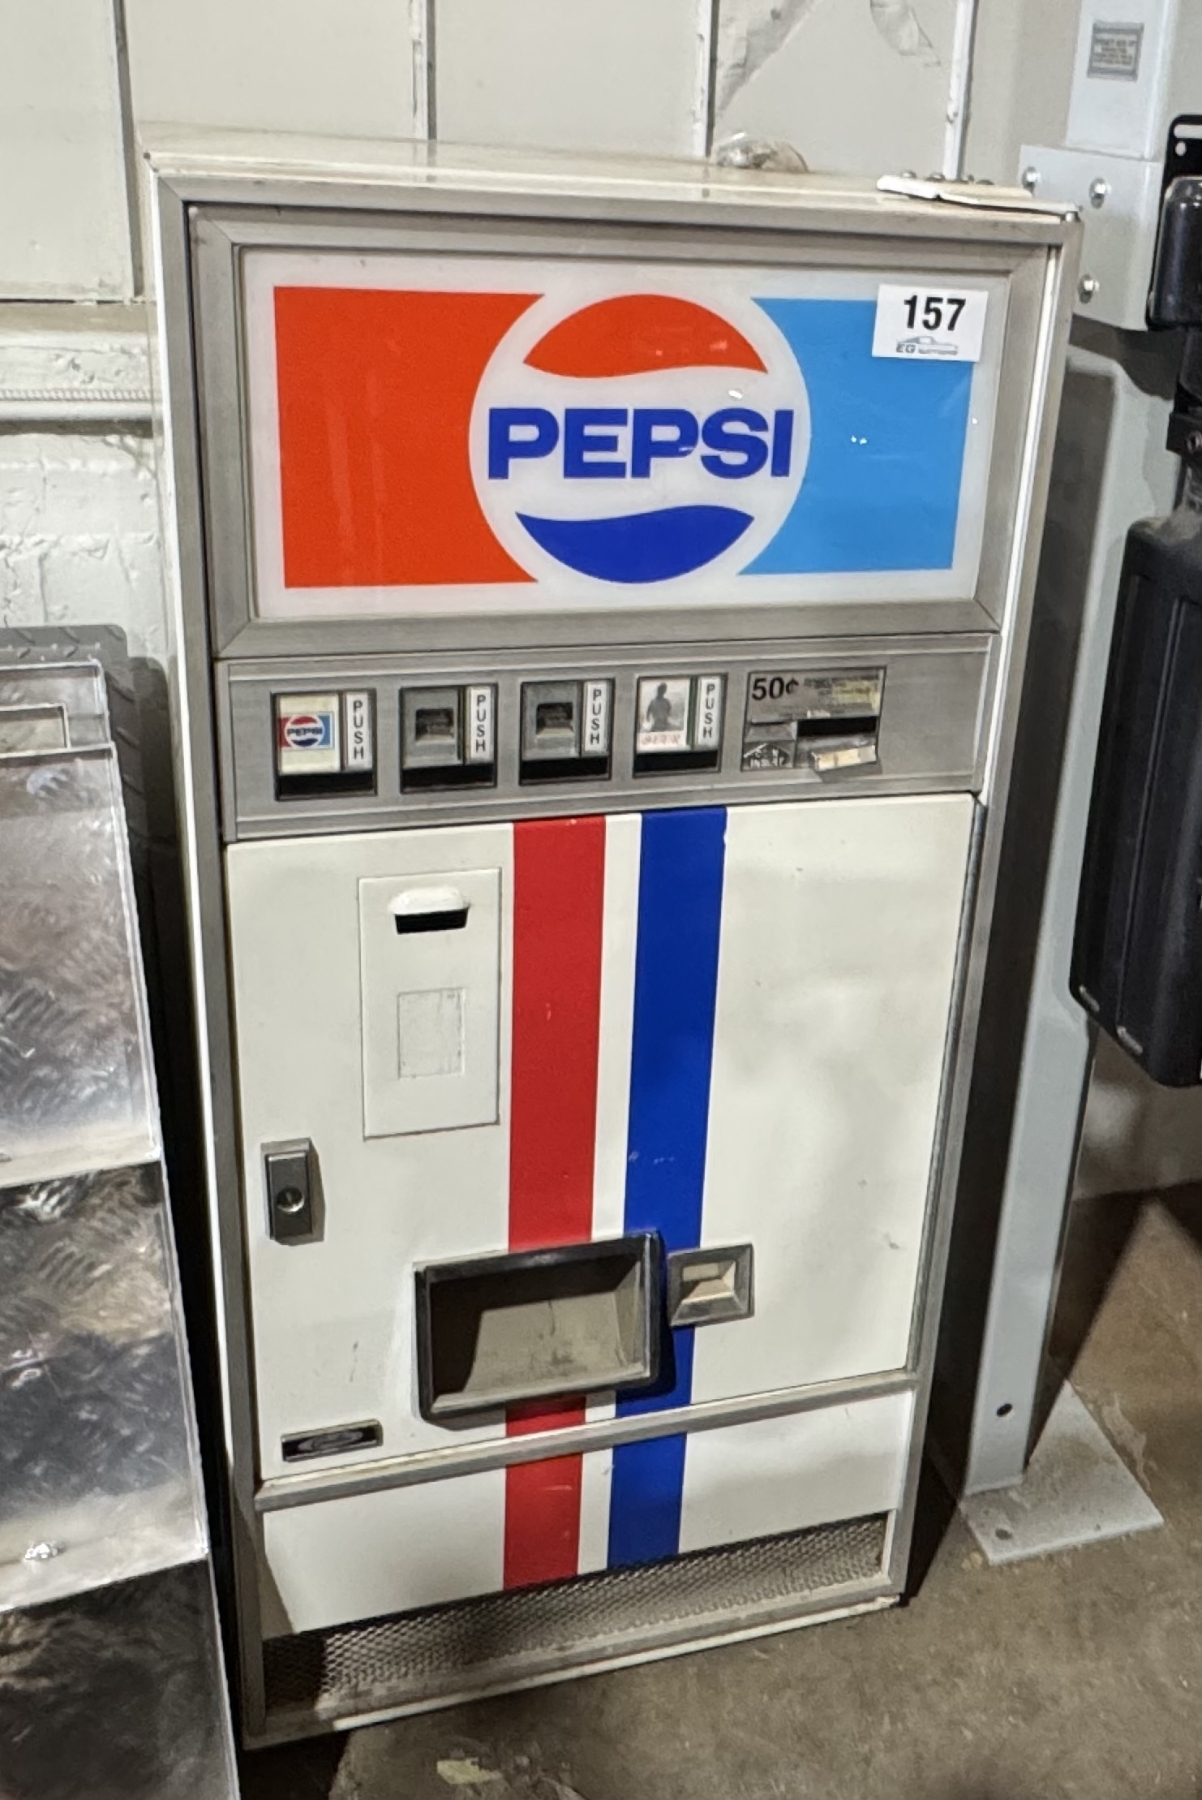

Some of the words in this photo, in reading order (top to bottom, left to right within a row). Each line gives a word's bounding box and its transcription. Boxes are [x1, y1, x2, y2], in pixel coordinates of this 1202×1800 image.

[903, 294, 966, 331] 157
[488, 407, 794, 479] PEPSI
[590, 688, 602, 745] PUSH
[703, 683, 716, 739] PUSH
[751, 676, 800, 701] 50¢
[286, 726, 324, 737] PEPSI
[353, 700, 364, 760] PUSH
[475, 694, 487, 753] PUSH
